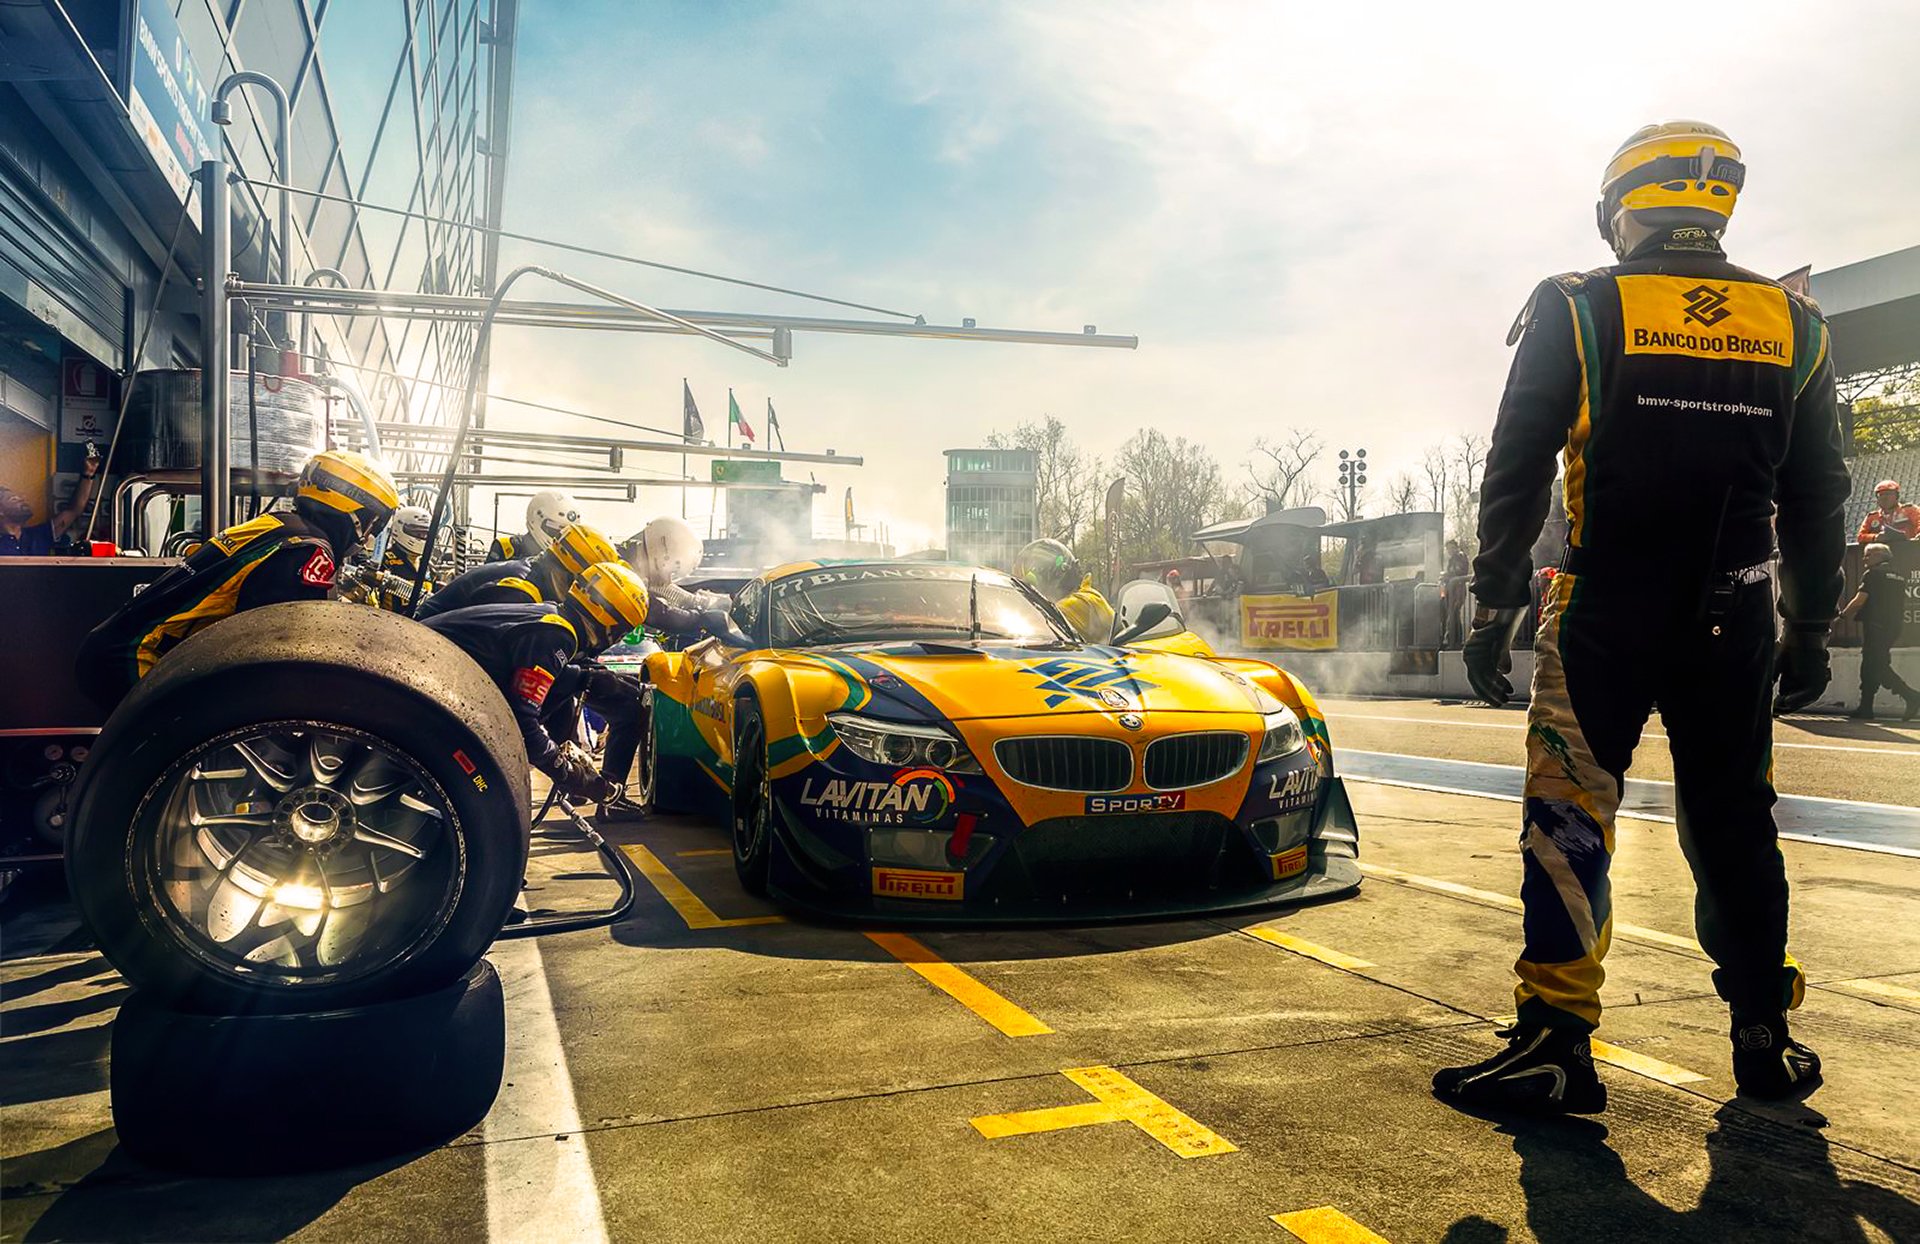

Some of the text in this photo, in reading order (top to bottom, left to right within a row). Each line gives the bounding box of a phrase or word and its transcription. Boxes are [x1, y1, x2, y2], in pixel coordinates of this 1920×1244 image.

[1634, 328, 1786, 358] BANCO DO BRASIL
[1637, 394, 1773, 417] bmw-sportstrophy.com
[773, 578, 803, 598] 77
[473, 774, 488, 792] DHC
[801, 778, 933, 811] LAVITAN
[816, 808, 904, 824] VITAMINAS
[879, 872, 955, 895] PIRELLI
